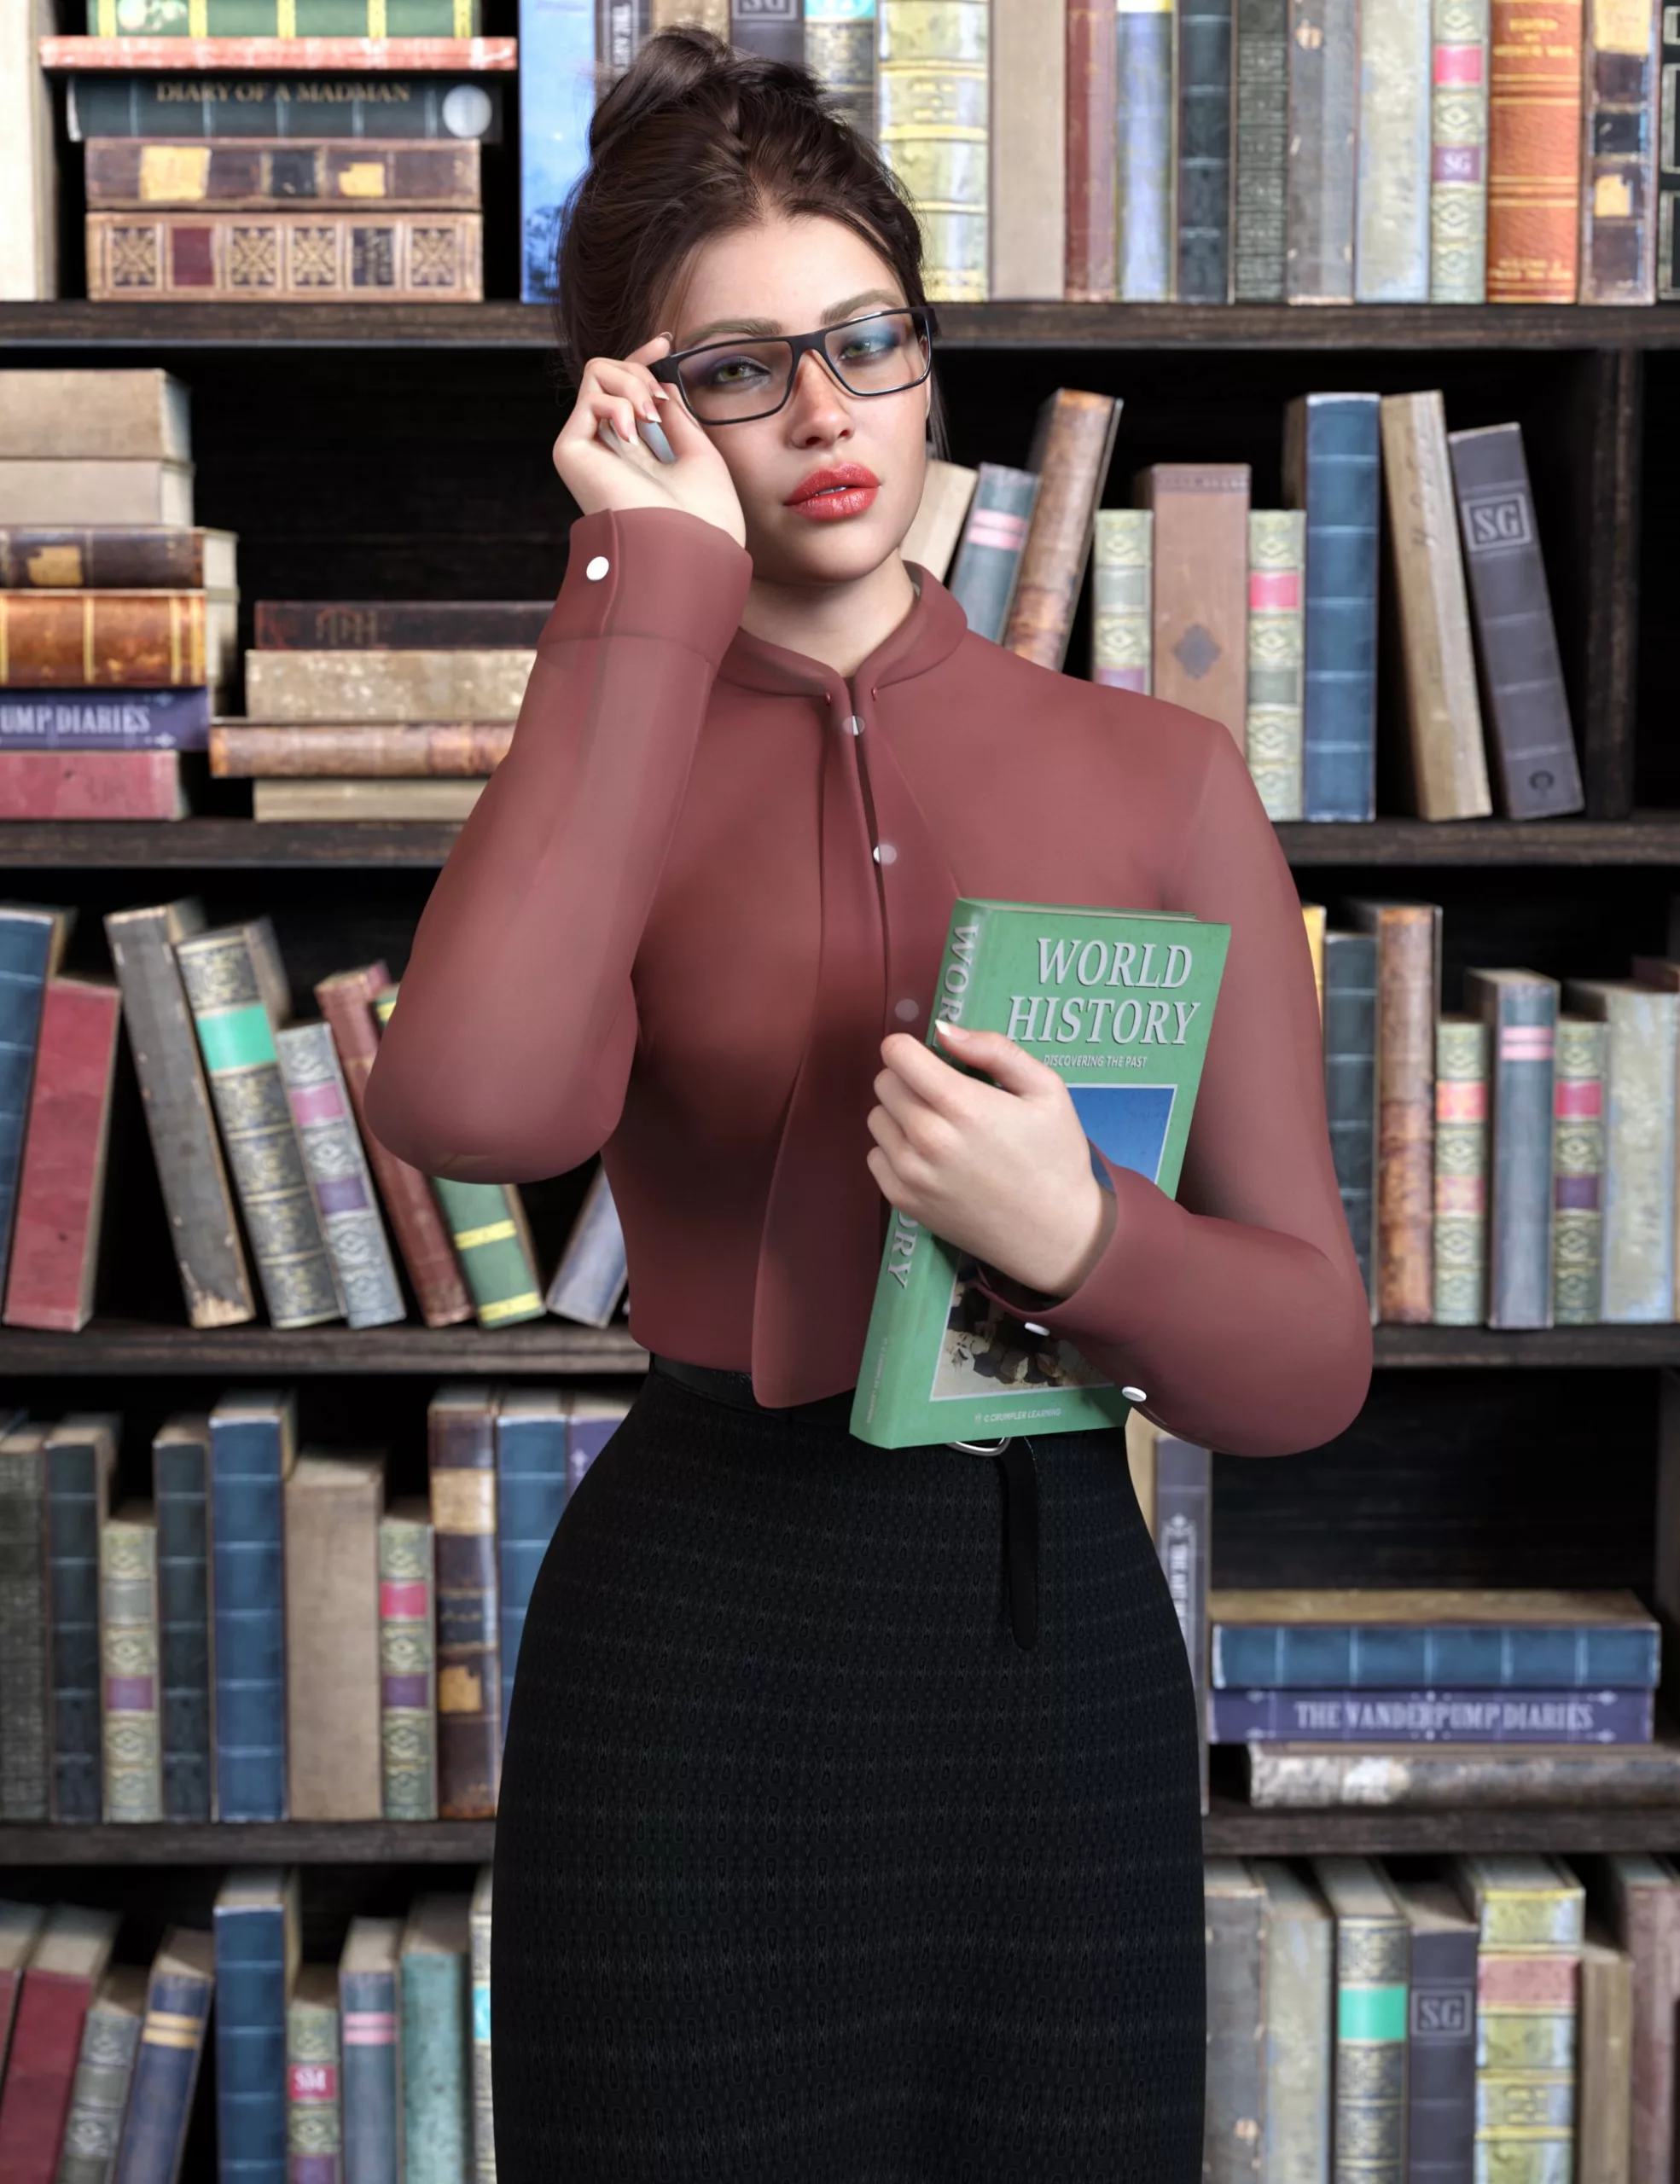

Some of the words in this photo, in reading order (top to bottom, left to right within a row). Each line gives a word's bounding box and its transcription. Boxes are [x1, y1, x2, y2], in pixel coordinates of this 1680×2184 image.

[156, 82, 230, 103] DIARY
[234, 82, 268, 103] OF
[273, 82, 294, 103] A
[296, 82, 410, 103] MADMAN
[1444, 152, 1472, 176] SG
[1474, 504, 1520, 543] SG
[0, 705, 52, 734] UMP
[55, 705, 150, 734] DIARIES
[1037, 938, 1193, 989] WORLD
[932, 924, 979, 1048] WOR
[1006, 996, 1200, 1045] HISTORY
[1043, 1054, 1104, 1067] DISCOVERING
[1107, 1056, 1124, 1067] THE
[1125, 1056, 1148, 1067] PAST
[1027, 1408, 1062, 1419] LEARNING
[1295, 1701, 1340, 1728] THE
[1345, 1701, 1500, 1729] VANDERPUMP
[1503, 1703, 1594, 1729] DIARIES
[1420, 1998, 1462, 2029] SG
